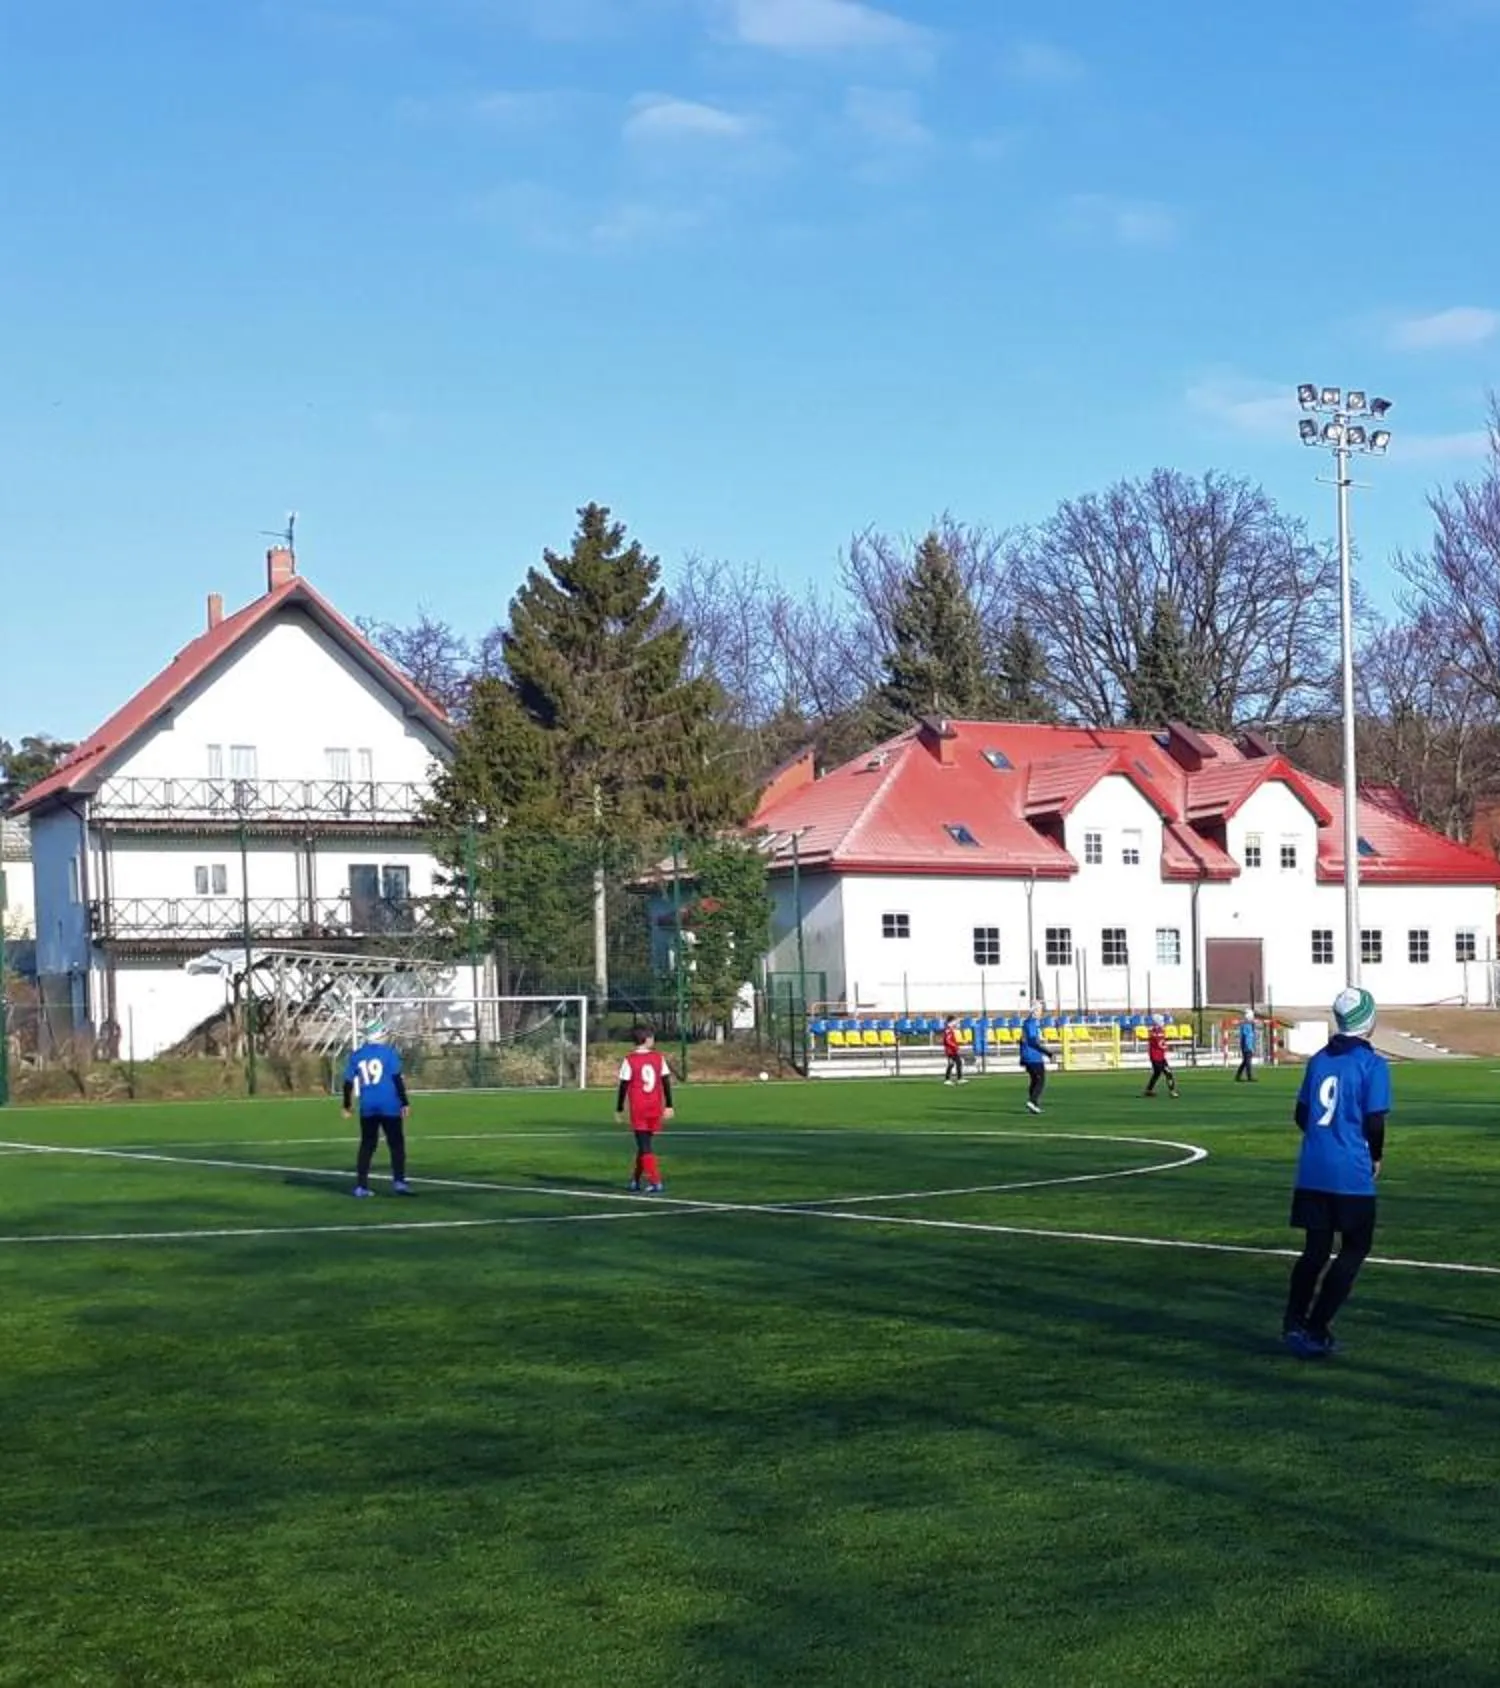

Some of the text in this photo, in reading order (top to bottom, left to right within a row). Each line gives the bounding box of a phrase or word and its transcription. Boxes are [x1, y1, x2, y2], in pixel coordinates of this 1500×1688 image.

[358, 1059, 383, 1085] 19
[641, 1063, 656, 1093] 9
[1317, 1075, 1338, 1126] 9
